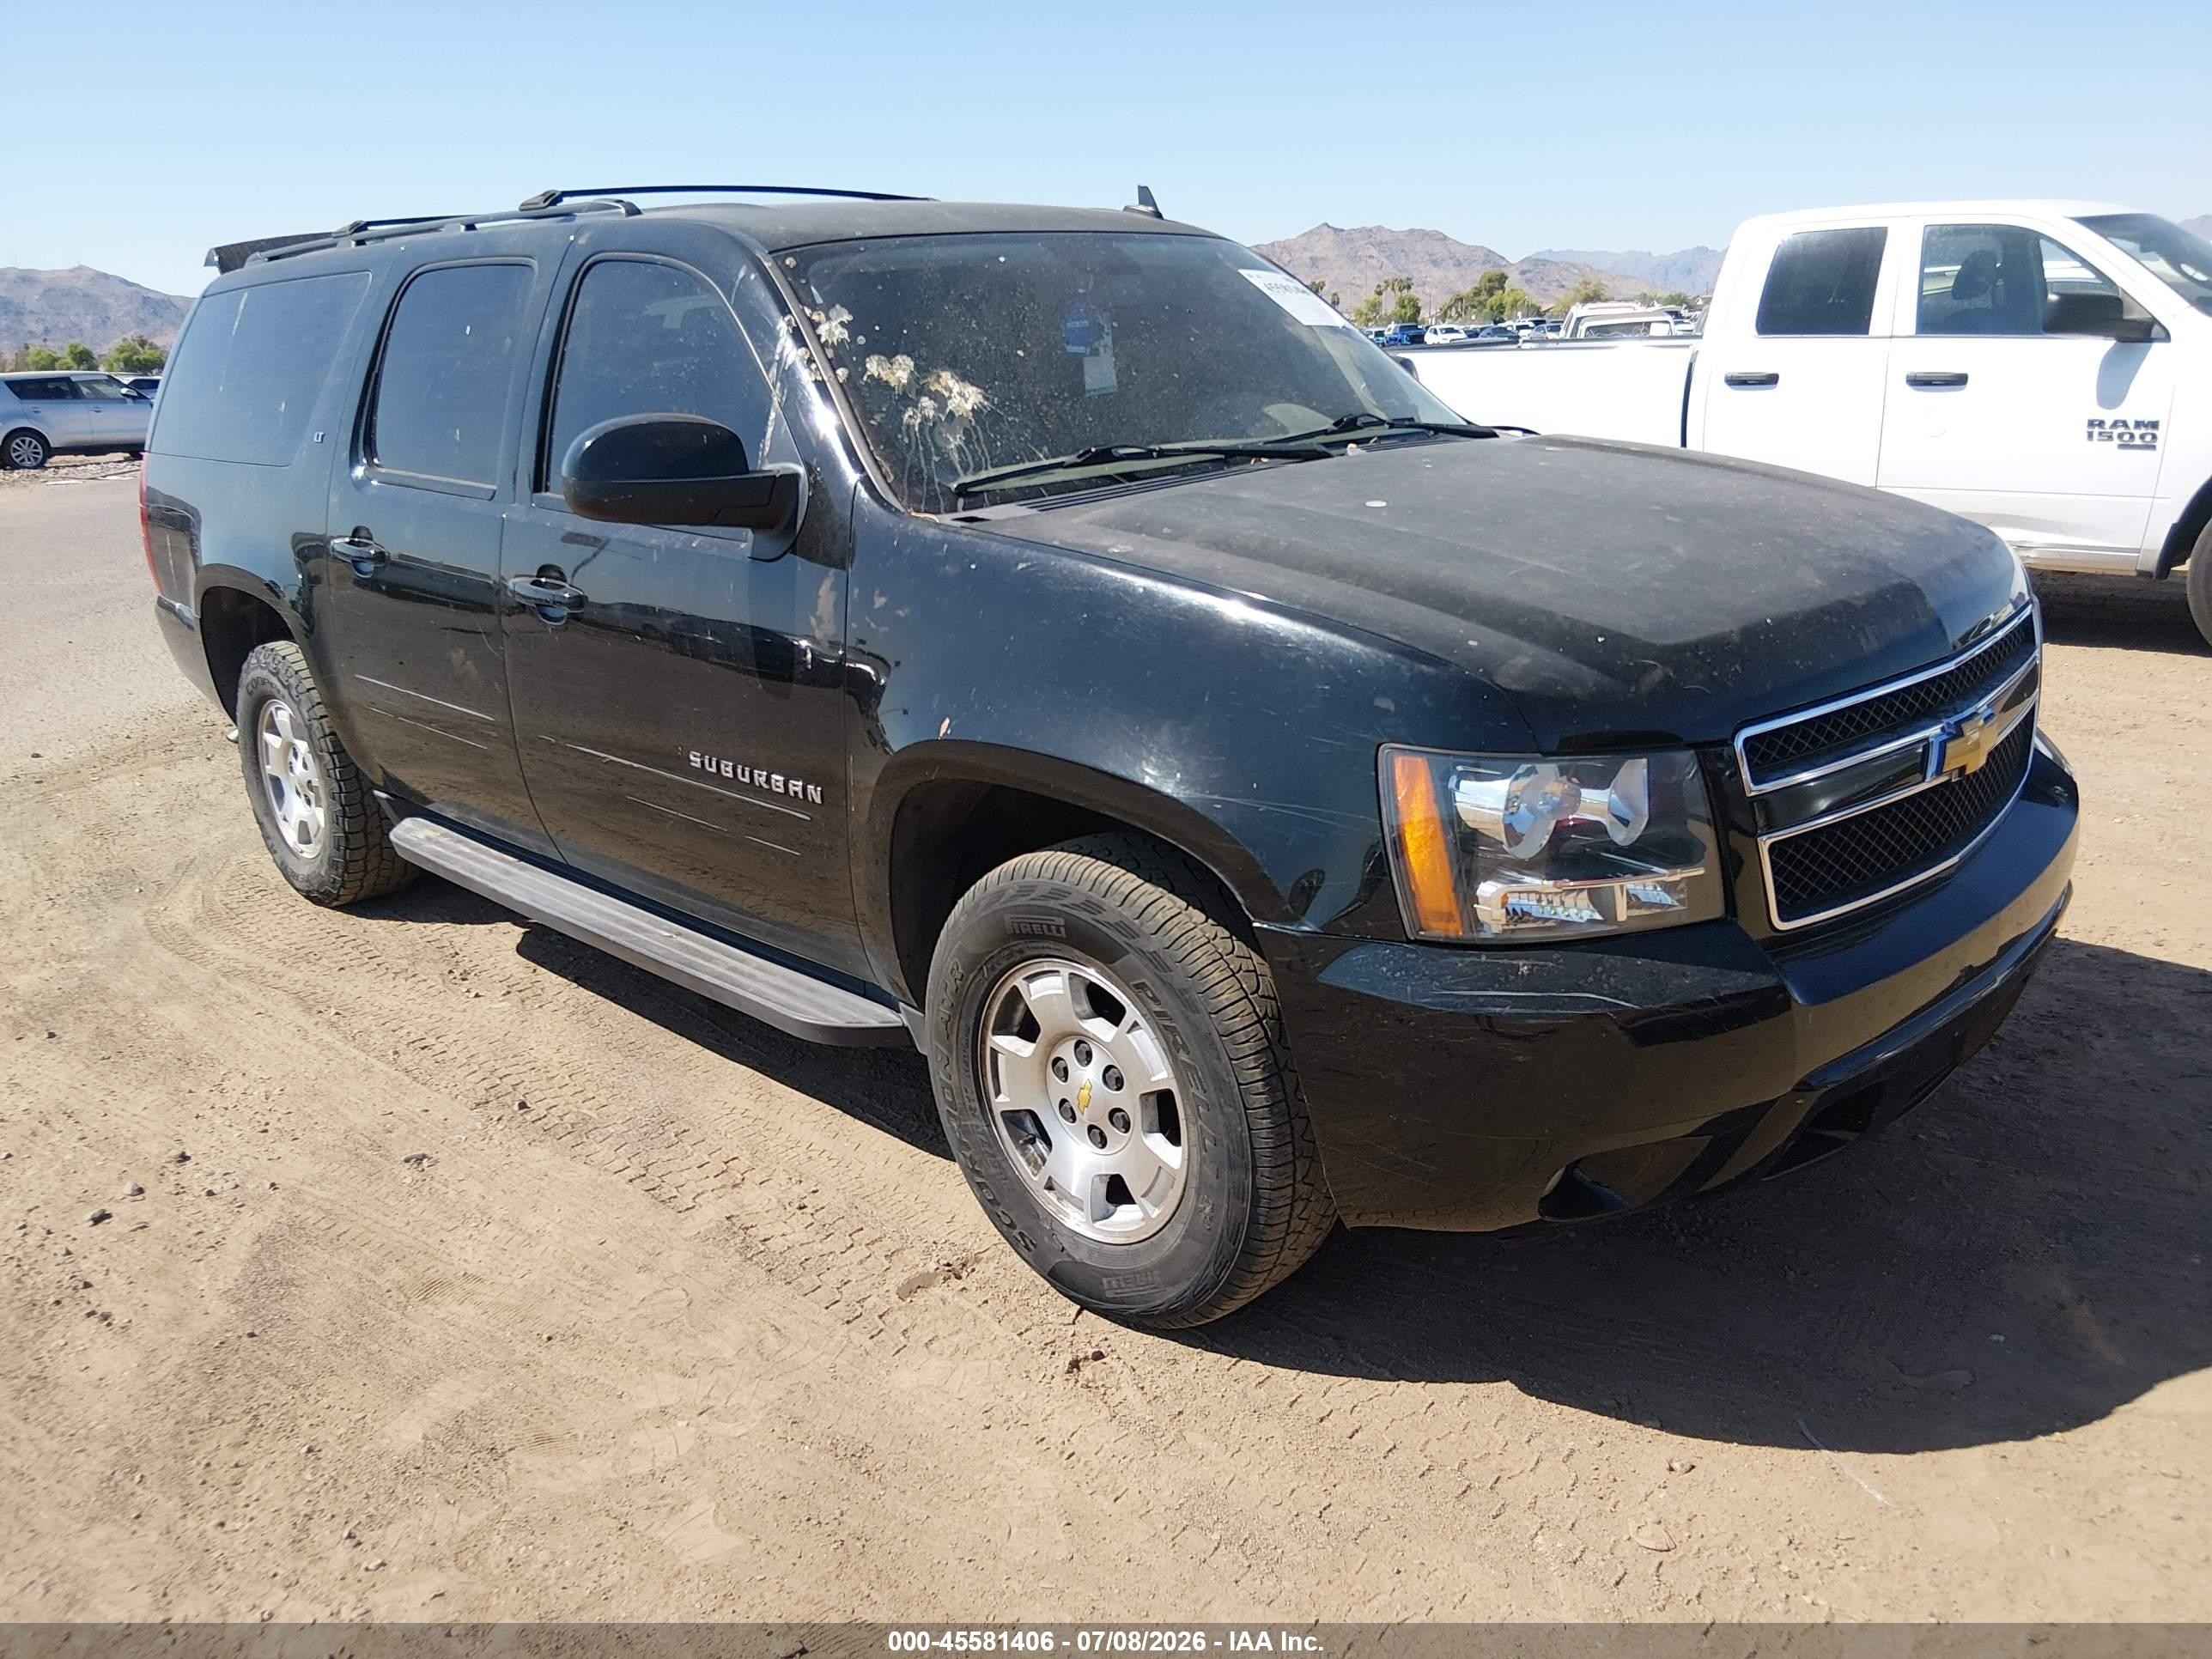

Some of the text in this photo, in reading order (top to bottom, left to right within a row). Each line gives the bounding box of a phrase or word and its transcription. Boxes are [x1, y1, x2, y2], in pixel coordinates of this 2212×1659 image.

[2087, 418, 2160, 430] RAM
[2087, 430, 2159, 444] 1500
[688, 750, 824, 805] SUBURBAN
[1004, 913, 1067, 939] PIRELLI
